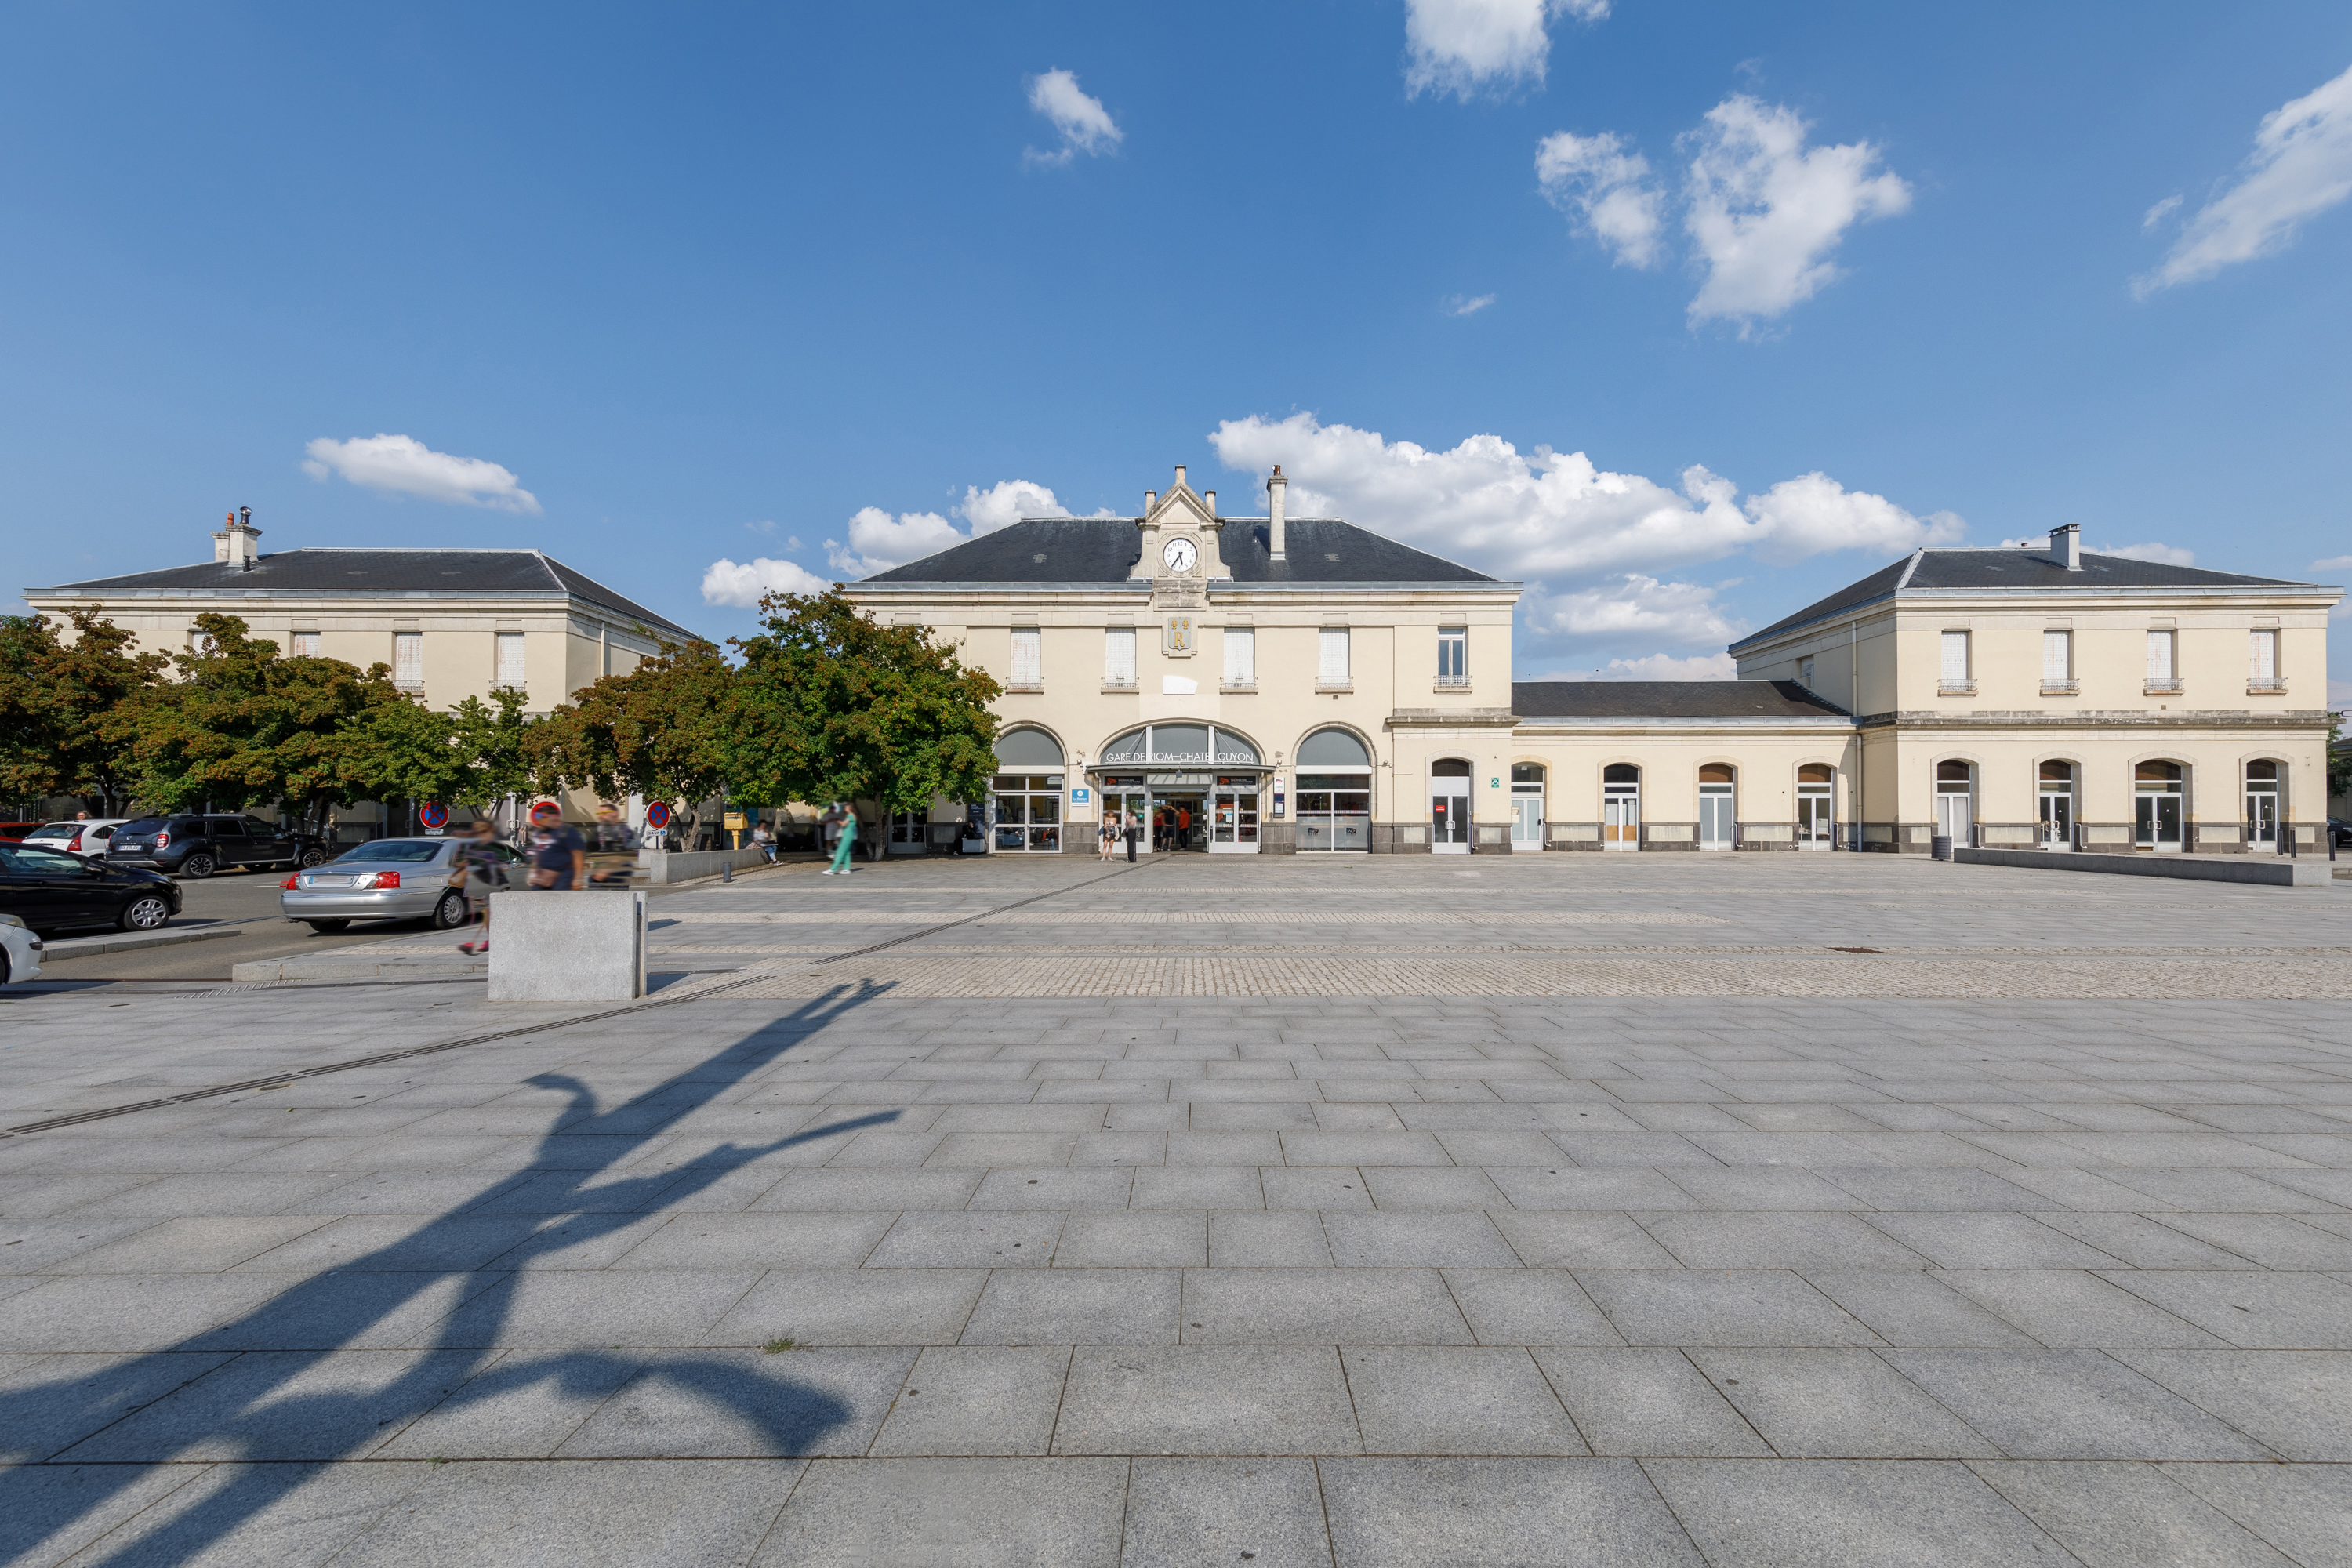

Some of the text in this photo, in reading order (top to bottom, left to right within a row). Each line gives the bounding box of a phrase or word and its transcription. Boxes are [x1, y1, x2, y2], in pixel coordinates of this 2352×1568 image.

[1174, 632, 1185, 647] R
[1106, 753, 1131, 762] GARE
[1134, 752, 1145, 761] DE
[1218, 752, 1254, 761] GUYON
